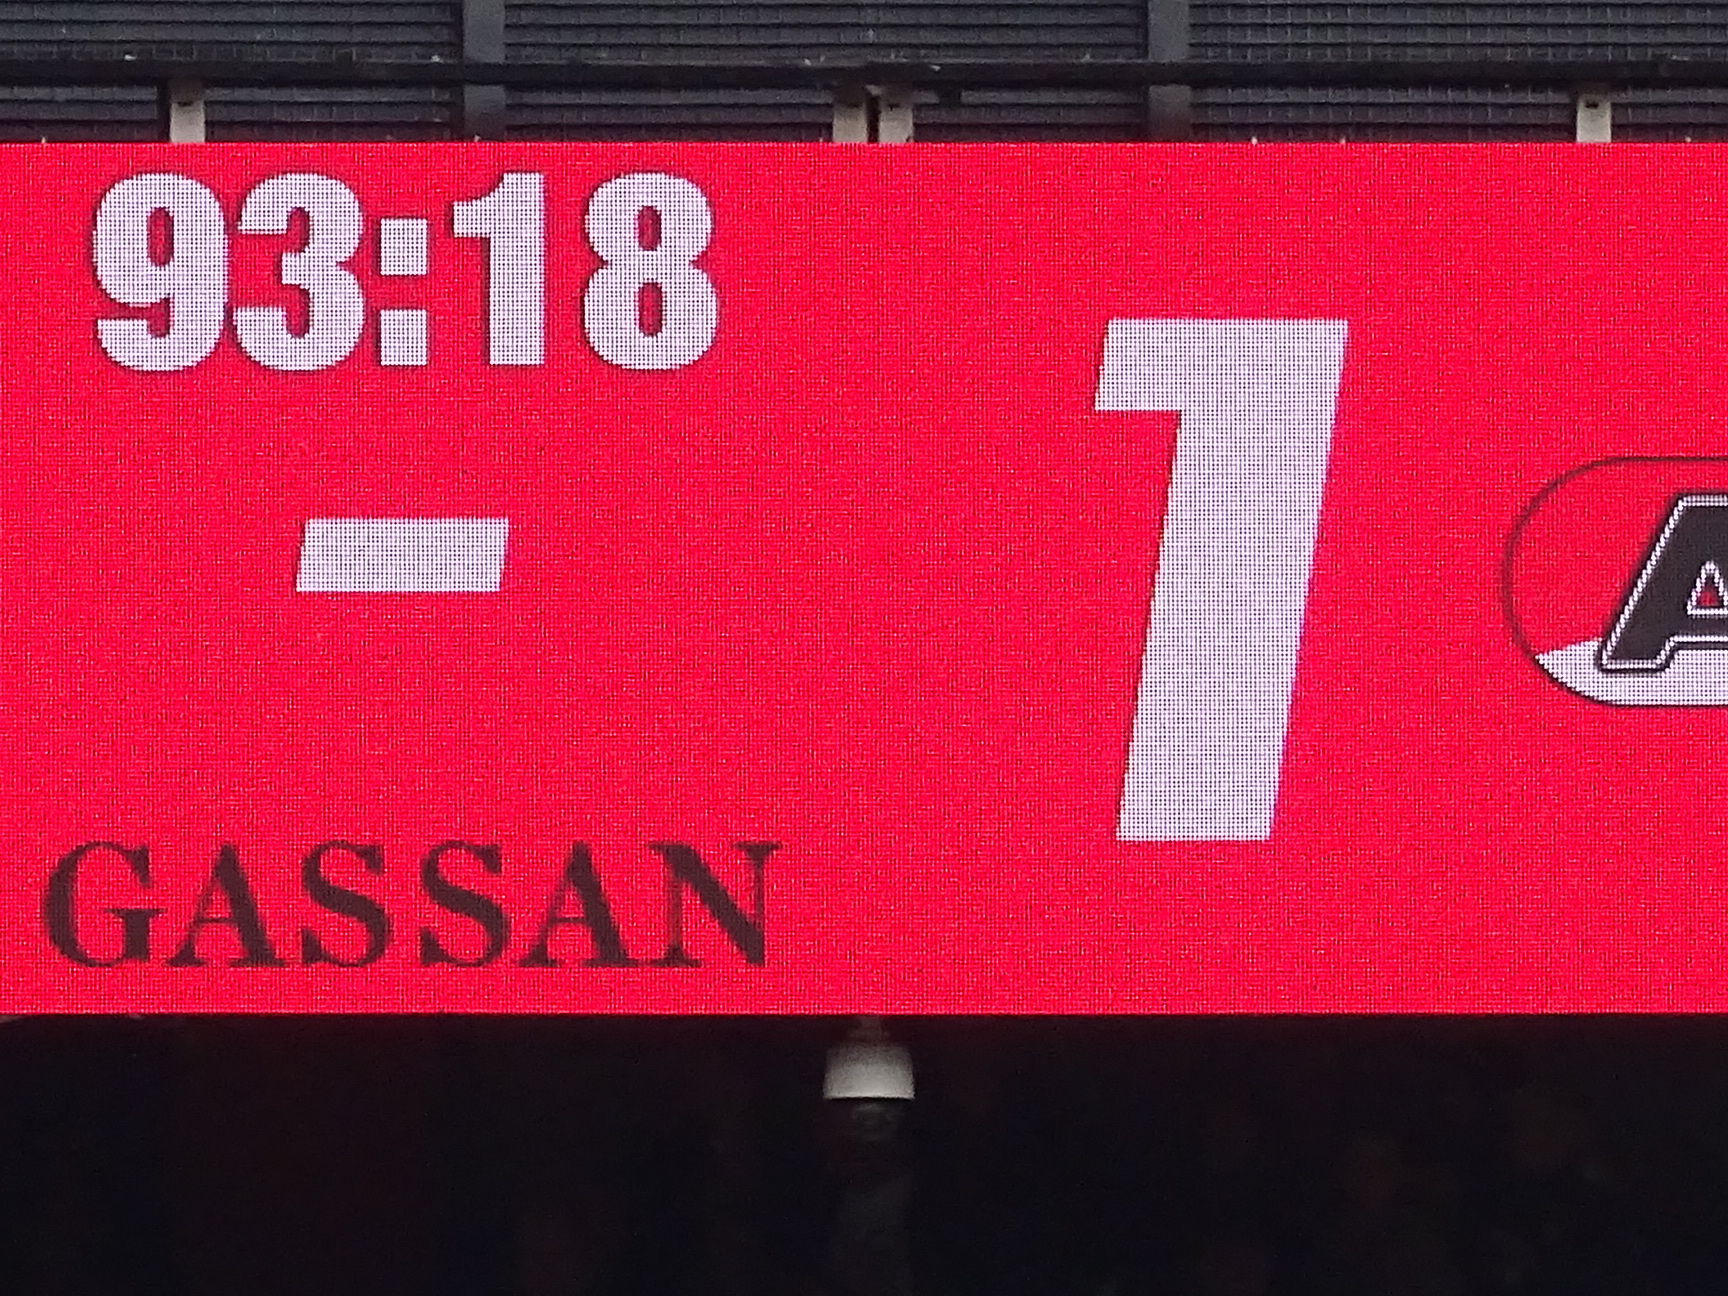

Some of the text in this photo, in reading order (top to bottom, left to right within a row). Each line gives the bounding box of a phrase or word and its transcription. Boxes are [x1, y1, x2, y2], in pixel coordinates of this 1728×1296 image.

[92, 172, 718, 371] 93:18
[1095, 318, 1348, 841] 1
[42, 840, 782, 970] GASSAN
